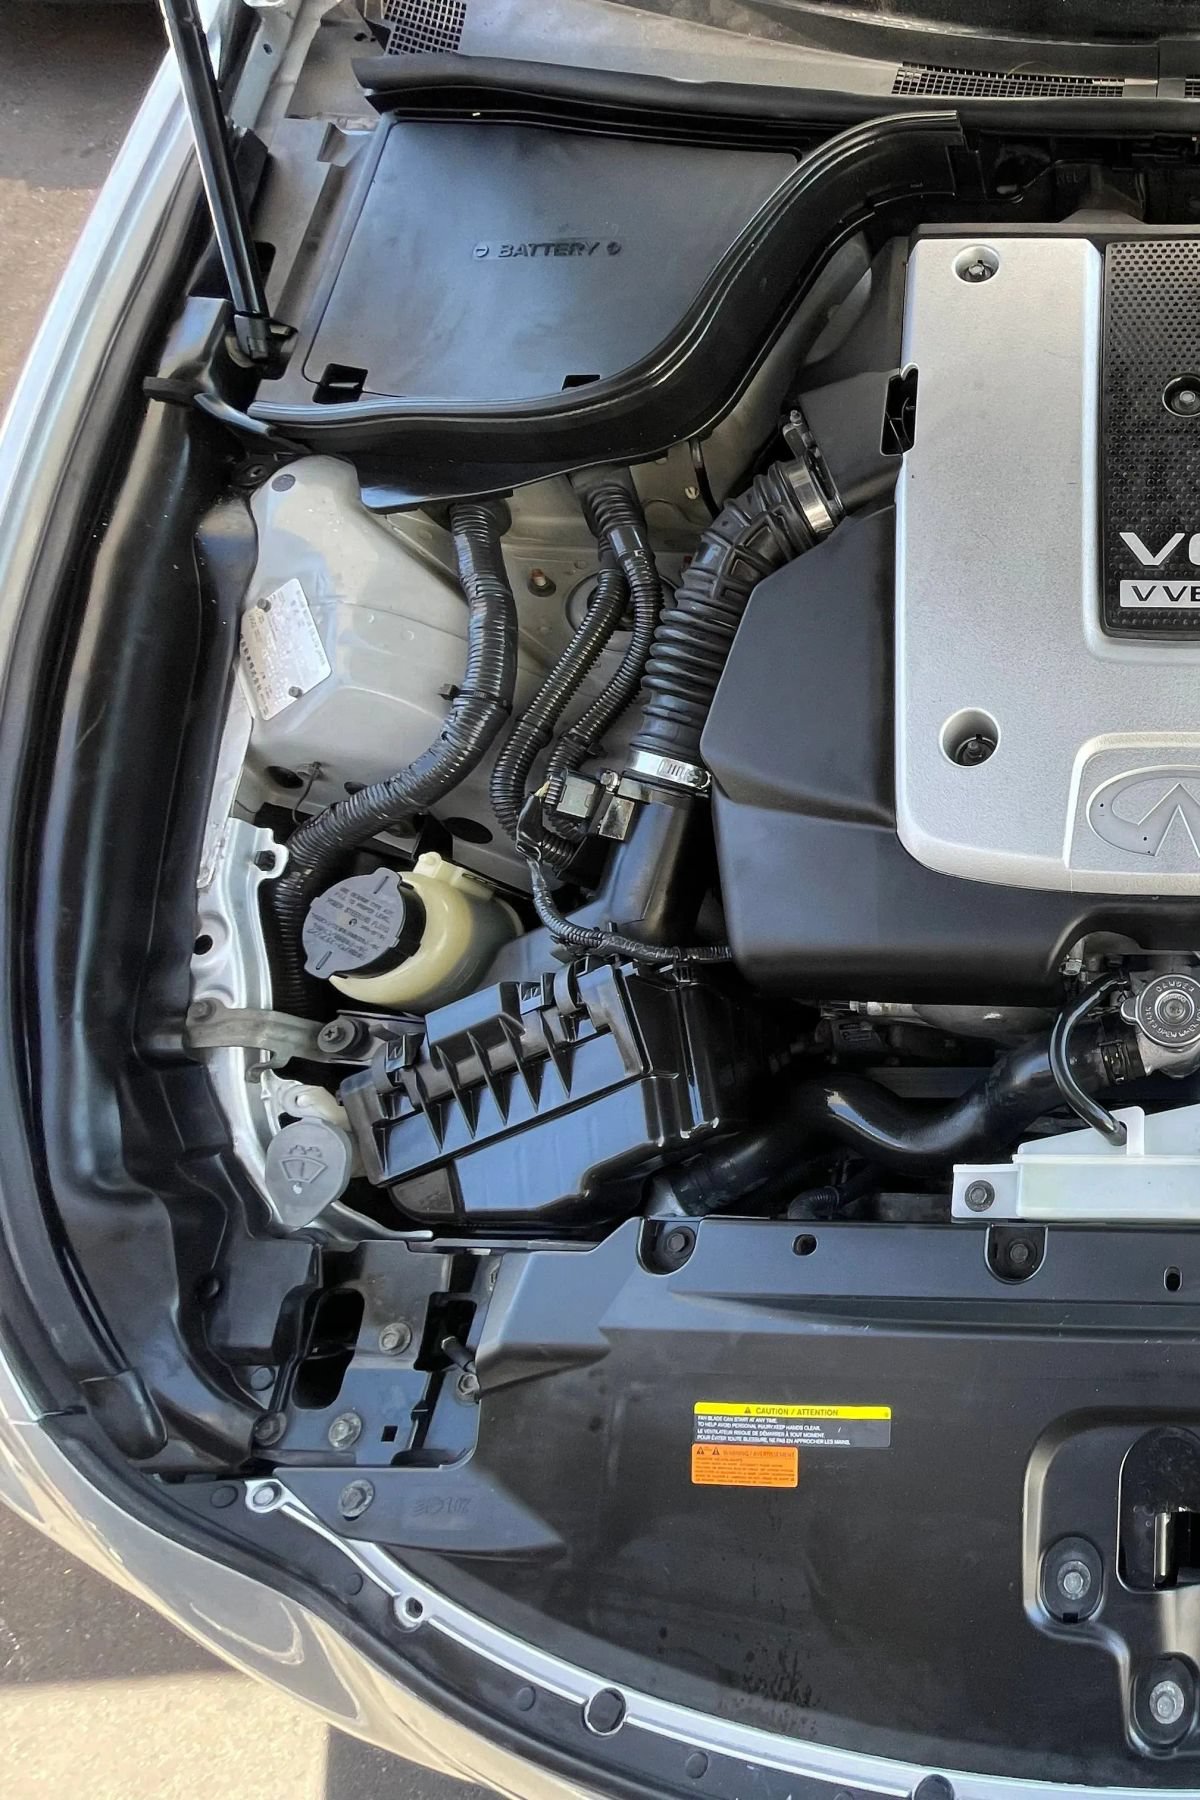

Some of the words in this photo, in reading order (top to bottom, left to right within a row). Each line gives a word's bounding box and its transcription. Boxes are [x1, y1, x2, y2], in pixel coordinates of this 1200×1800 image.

[498, 241, 600, 258] BATTERY
[756, 1407, 789, 1415] CAUTION
[796, 1408, 839, 1416] ATTENTION
